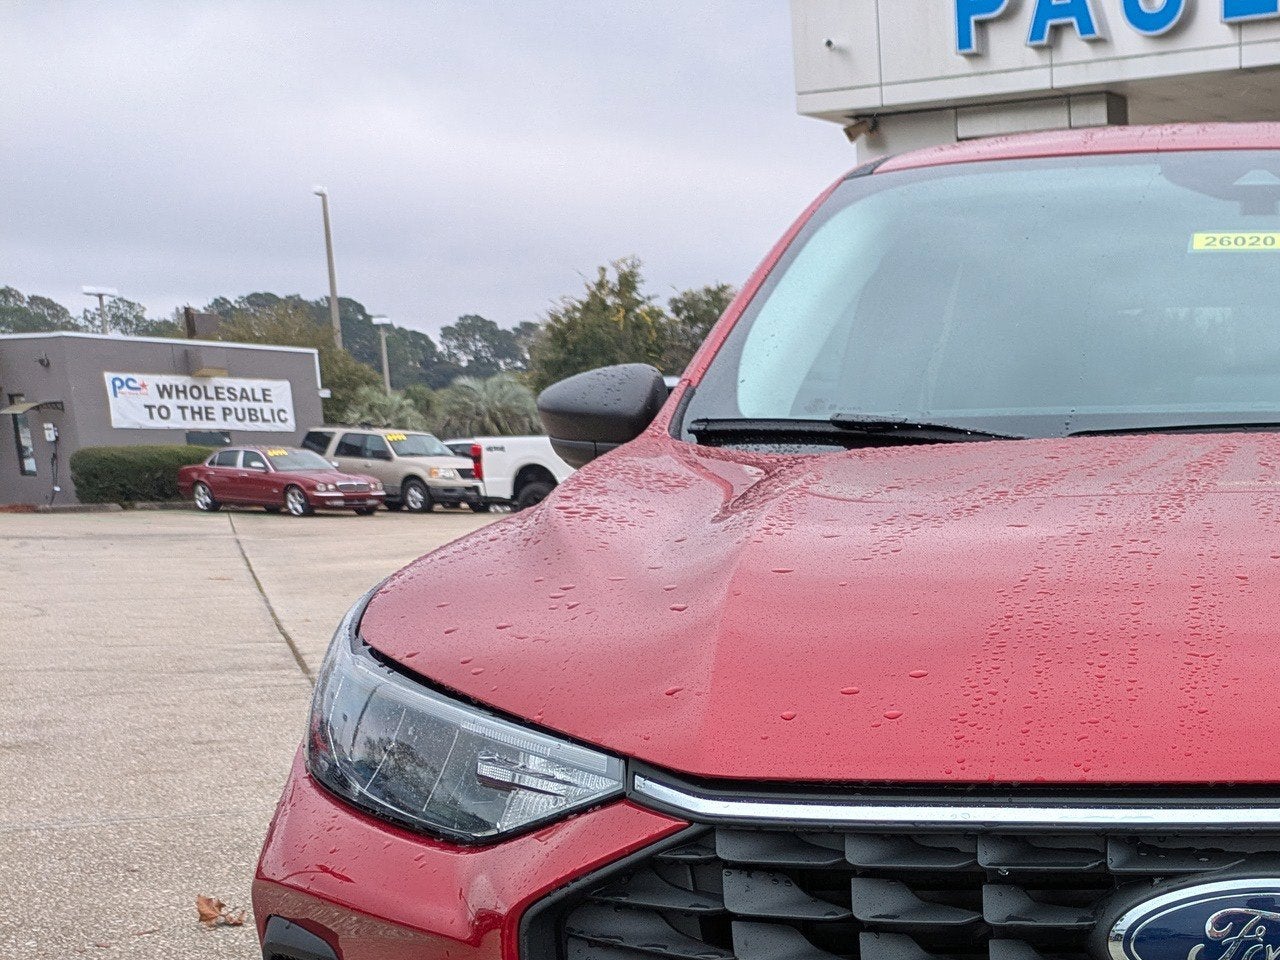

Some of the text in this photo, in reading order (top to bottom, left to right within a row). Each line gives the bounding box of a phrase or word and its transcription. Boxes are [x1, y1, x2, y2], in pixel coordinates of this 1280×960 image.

[1204, 235, 1276, 247] 26020
[156, 383, 273, 403] WHOLESALE
[144, 404, 288, 423] TO THE PUBLIC
